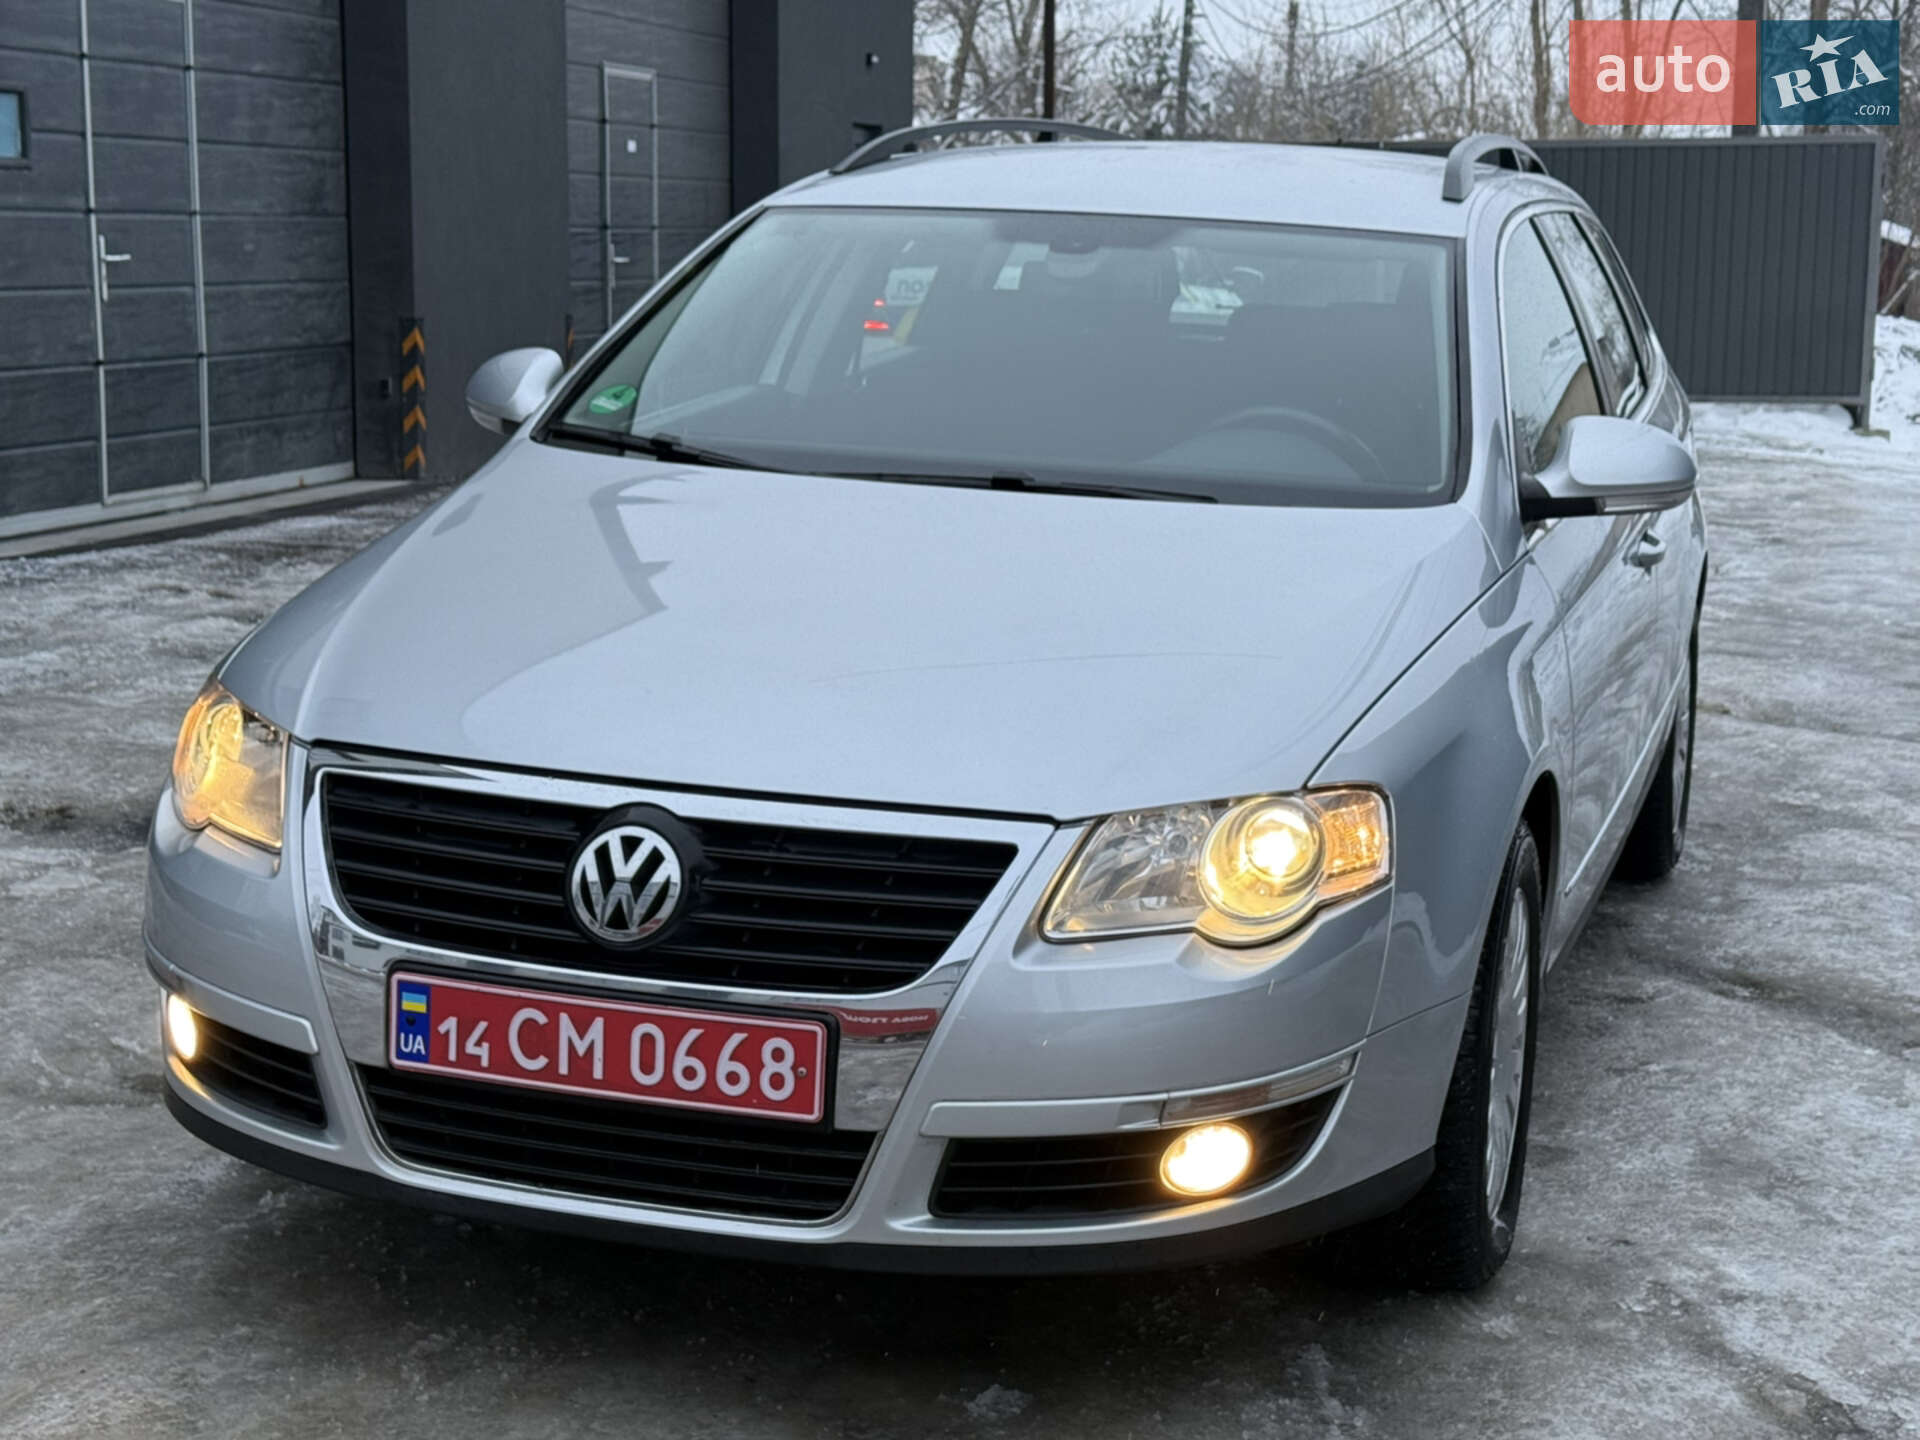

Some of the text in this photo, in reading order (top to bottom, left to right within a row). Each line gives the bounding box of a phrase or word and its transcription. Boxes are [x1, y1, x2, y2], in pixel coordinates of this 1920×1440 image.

[400, 1031, 426, 1056] UA
[437, 1007, 796, 1102] 14 CM 0668
